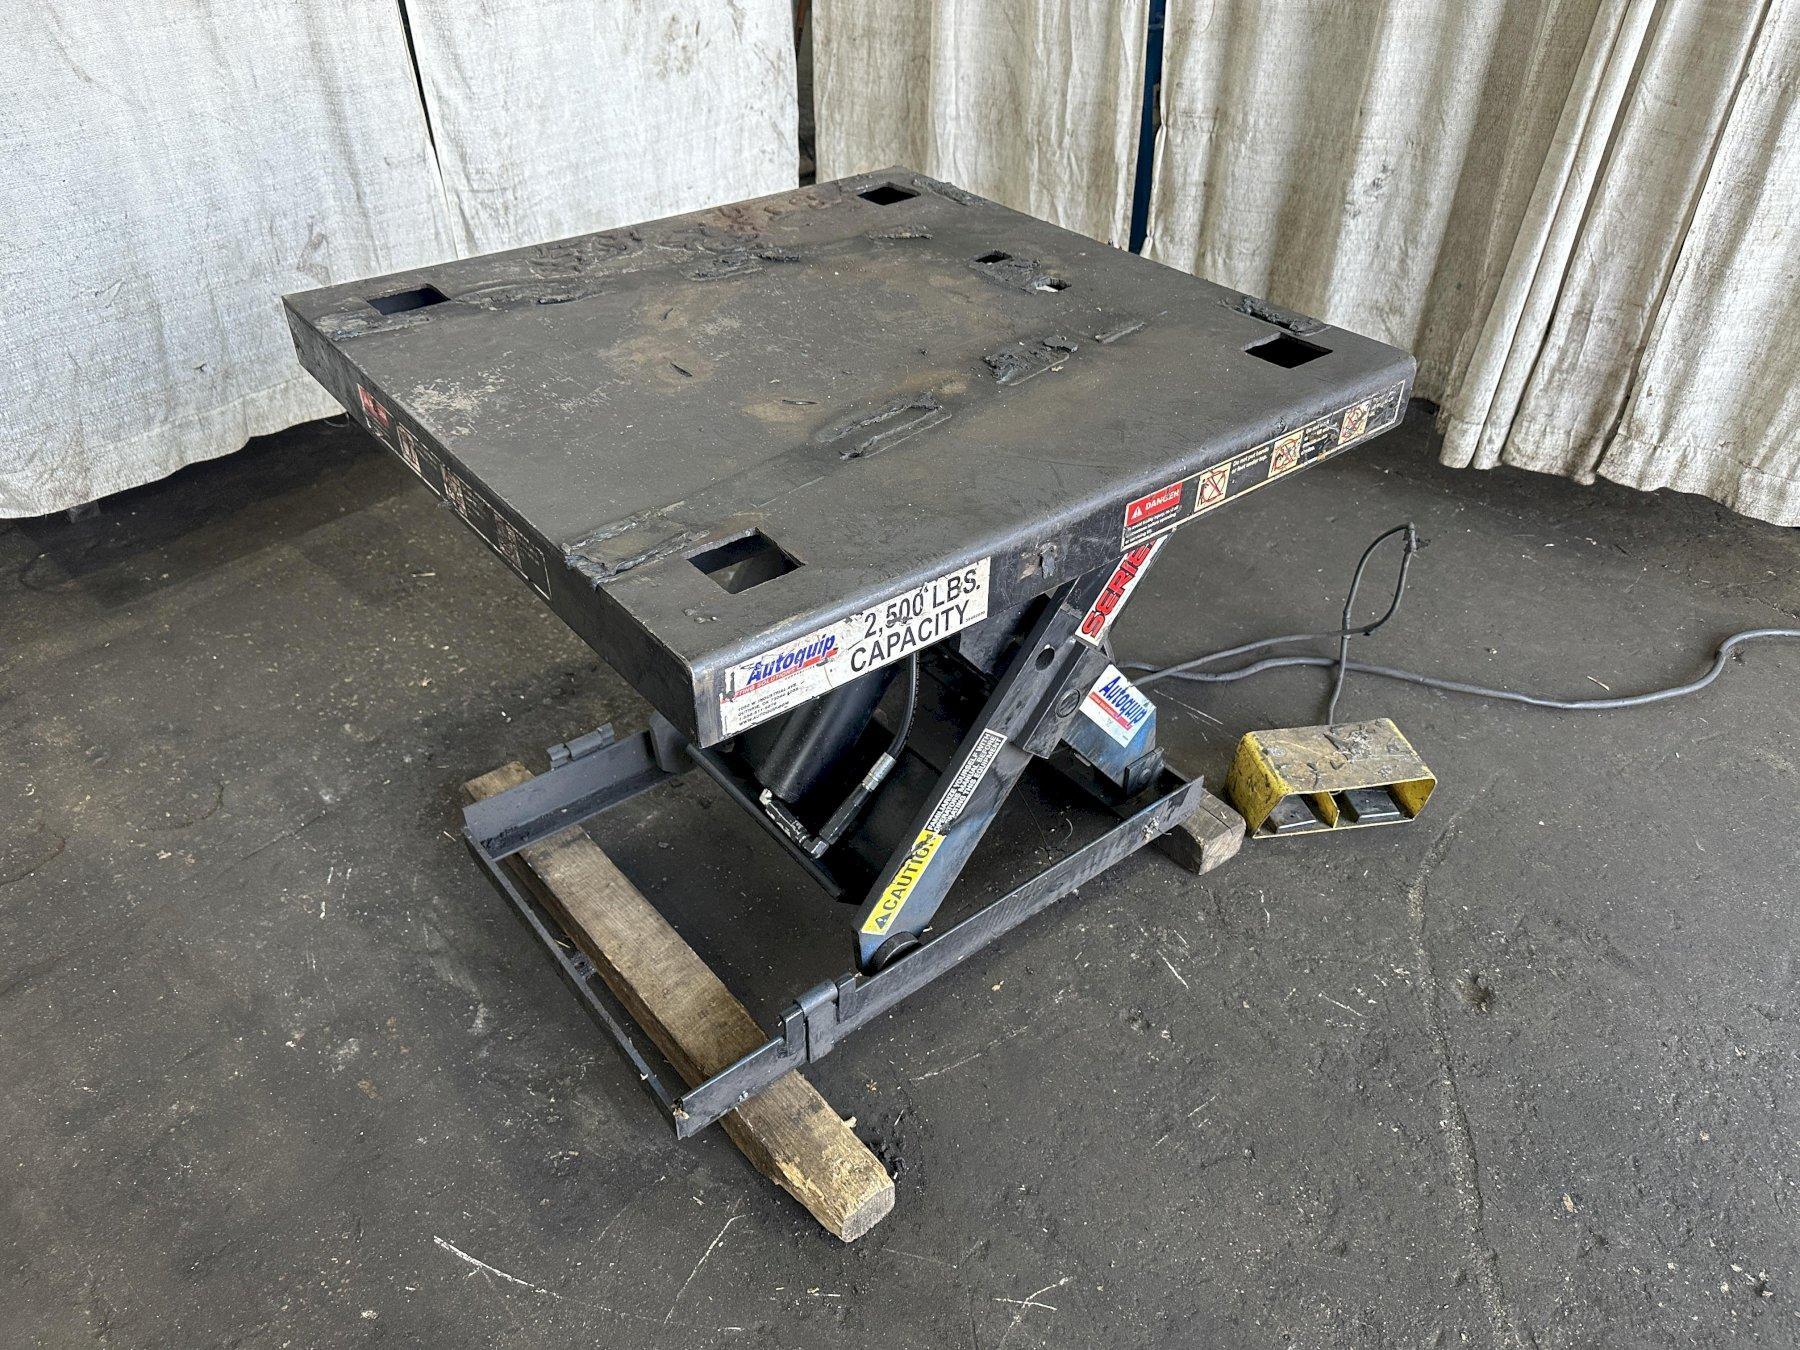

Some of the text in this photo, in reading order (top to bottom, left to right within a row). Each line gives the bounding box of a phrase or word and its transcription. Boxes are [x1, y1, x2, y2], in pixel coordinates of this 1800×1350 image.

[864, 568, 981, 640] 2,500 LBS.
[1082, 539, 1156, 638] SERIE
[746, 634, 836, 685] Autoquip
[850, 600, 969, 673] CAPACITY
[1099, 676, 1147, 726] Autoquip
[927, 732, 991, 830] FAMILIARIZE YOURSELF WITH
[932, 734, 996, 833] OPERATORS MANUAL BEFORE
[963, 777, 976, 795] THIS
[973, 737, 1002, 778] EQUIPMENT
